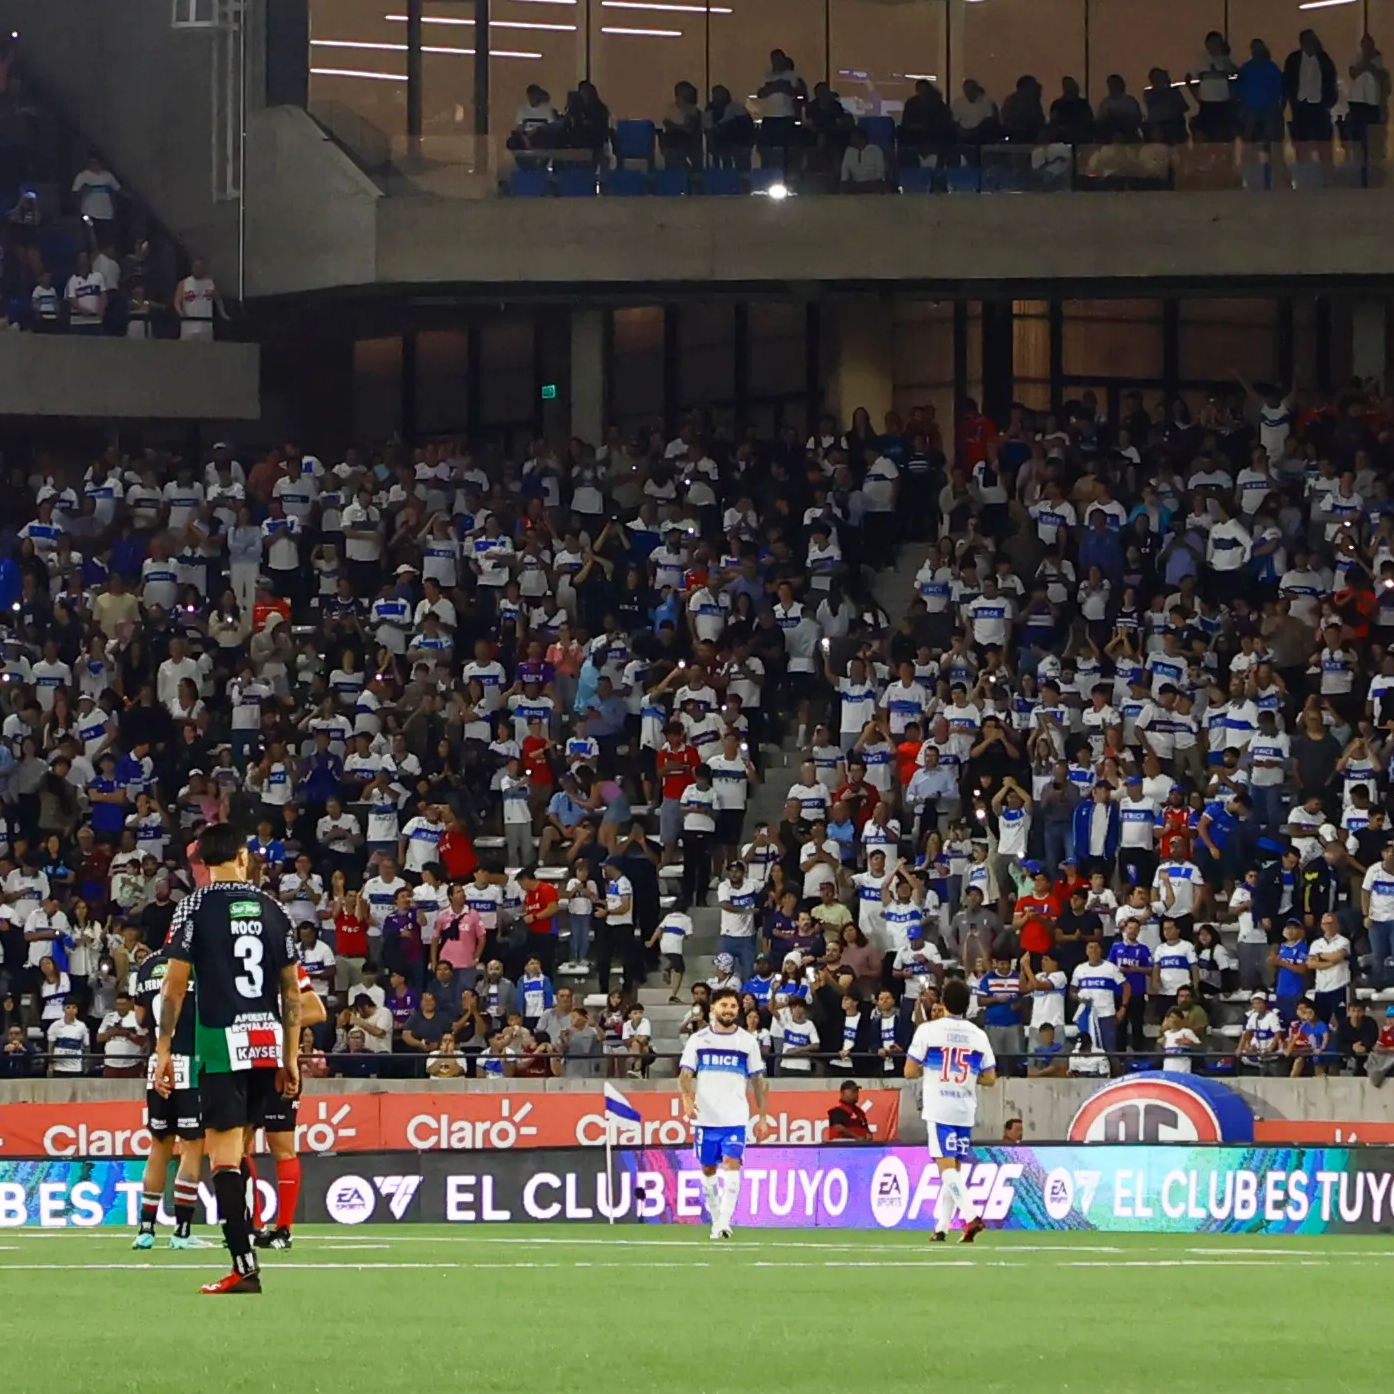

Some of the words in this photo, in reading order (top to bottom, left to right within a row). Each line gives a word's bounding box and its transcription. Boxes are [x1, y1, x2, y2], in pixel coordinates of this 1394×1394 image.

[230, 920, 263, 936] ROCO
[234, 936, 264, 998] 3
[712, 1055, 739, 1066] BICE
[939, 1046, 971, 1084] 15
[43, 1123, 153, 1156] Claro
[406, 1114, 519, 1149] Claro
[747, 1112, 829, 1145] Clar
[38, 1182, 104, 1227] ES
[446, 1175, 511, 1221] EL
[523, 1171, 665, 1219] CLUB
[744, 1168, 849, 1216] TUYO
[1113, 1170, 1153, 1218] EL
[1161, 1170, 1256, 1220] CLUB
[1265, 1170, 1308, 1221] ES
